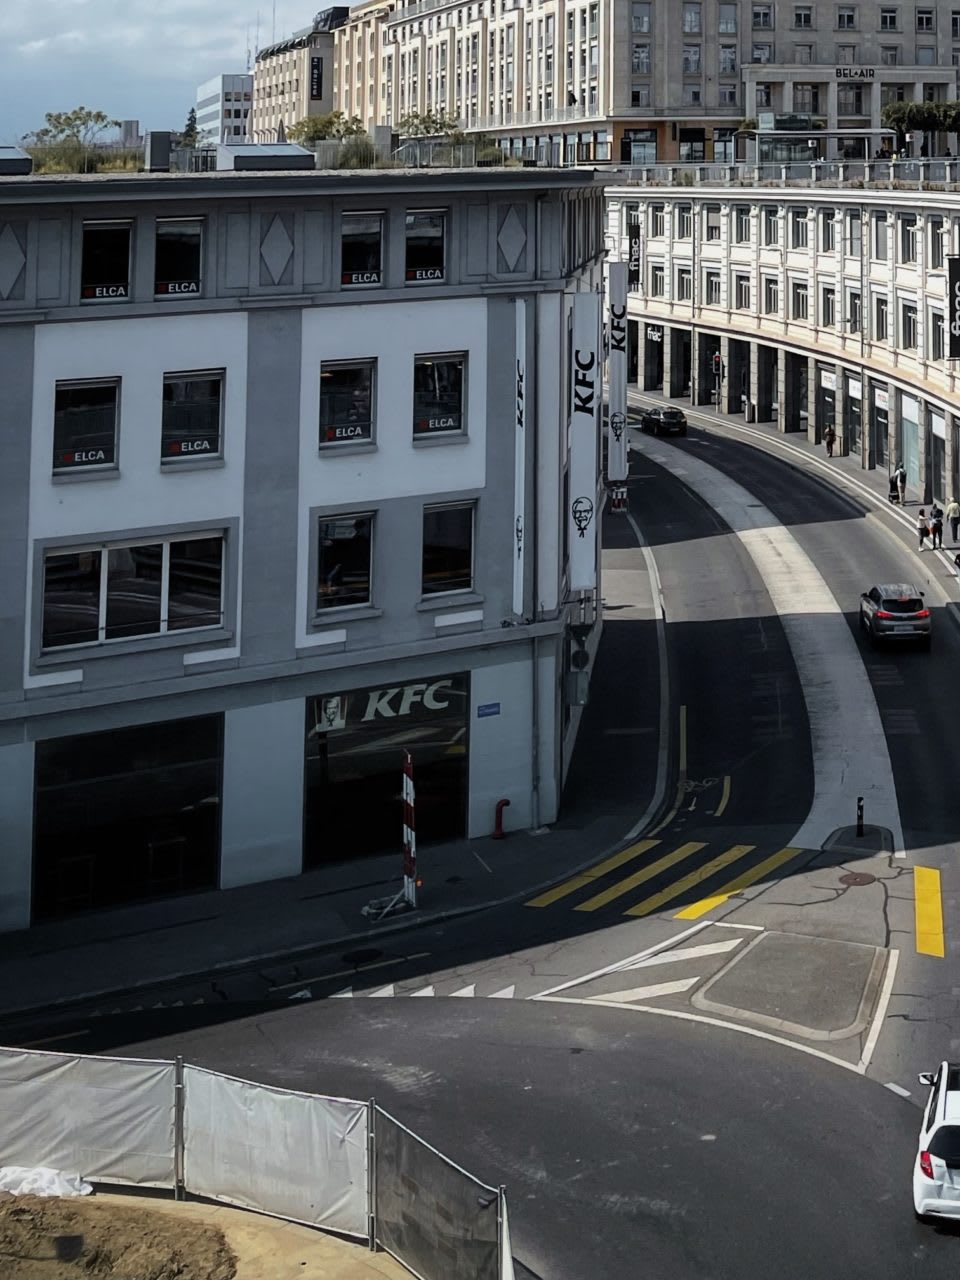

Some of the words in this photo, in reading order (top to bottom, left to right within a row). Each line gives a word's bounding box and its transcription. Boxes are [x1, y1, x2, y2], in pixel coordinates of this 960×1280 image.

[628, 238, 639, 271] fnac
[352, 273, 378, 282] ELCA
[416, 269, 441, 279] ELCA
[95, 286, 125, 297] ELCA
[168, 282, 197, 293] ELCA
[610, 304, 626, 353] KFC
[574, 349, 595, 417] KFC
[516, 359, 525, 428] KFC
[429, 418, 454, 428] ELCA
[335, 427, 362, 437] ELCA
[181, 440, 210, 451] ELCA
[74, 450, 105, 462] ELCA
[360, 679, 453, 722] KFC
